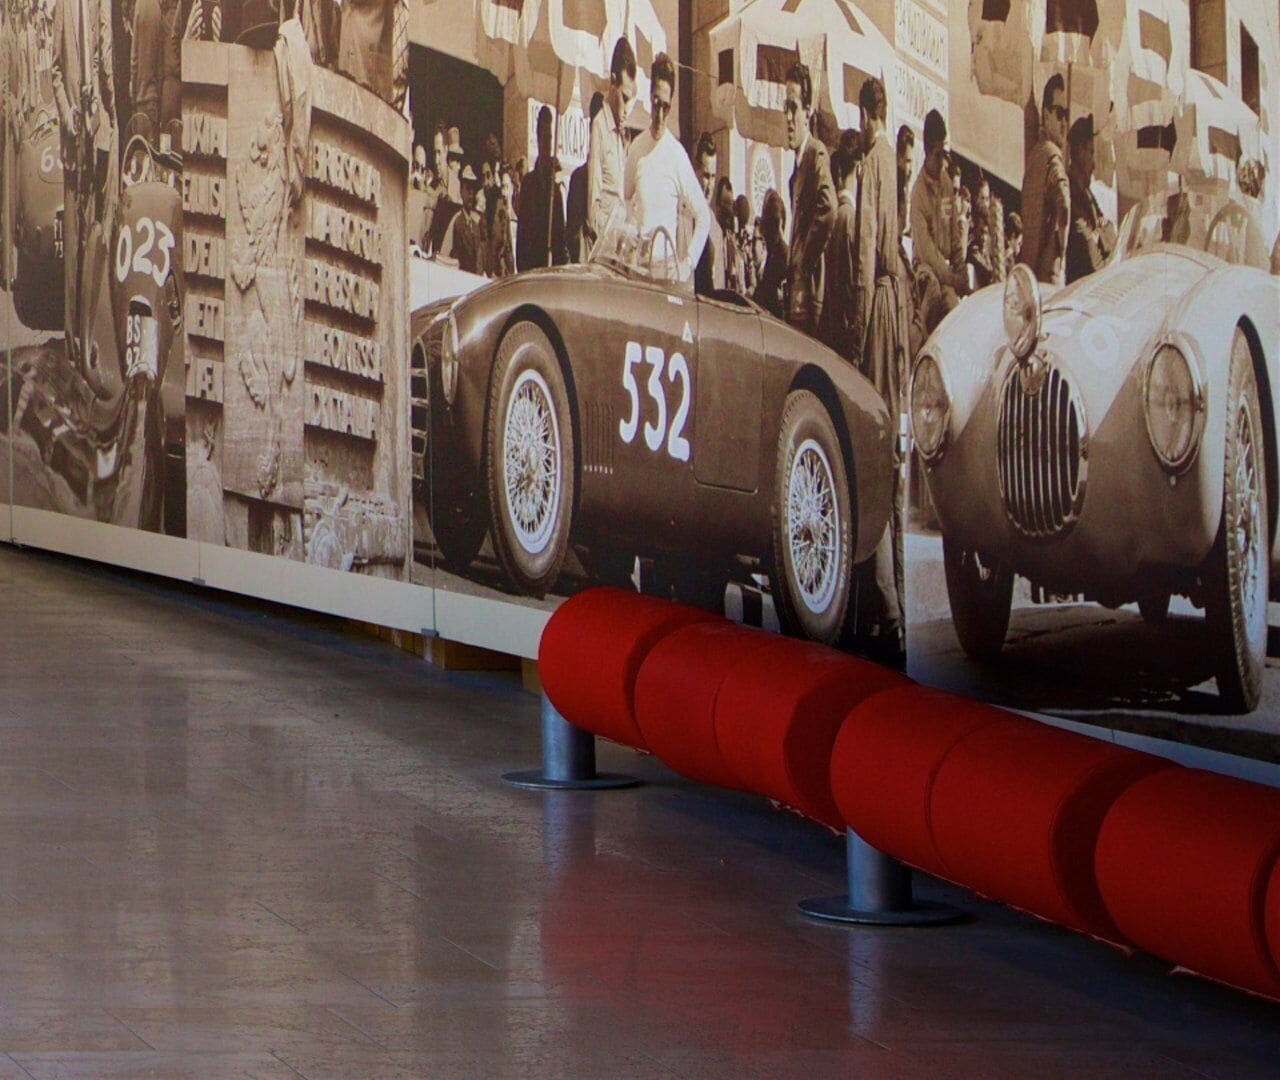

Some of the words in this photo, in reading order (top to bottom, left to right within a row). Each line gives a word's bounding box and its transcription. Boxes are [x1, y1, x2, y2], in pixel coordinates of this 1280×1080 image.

[116, 217, 176, 287] 023
[126, 314, 140, 345] BS
[619, 340, 690, 463] 532
